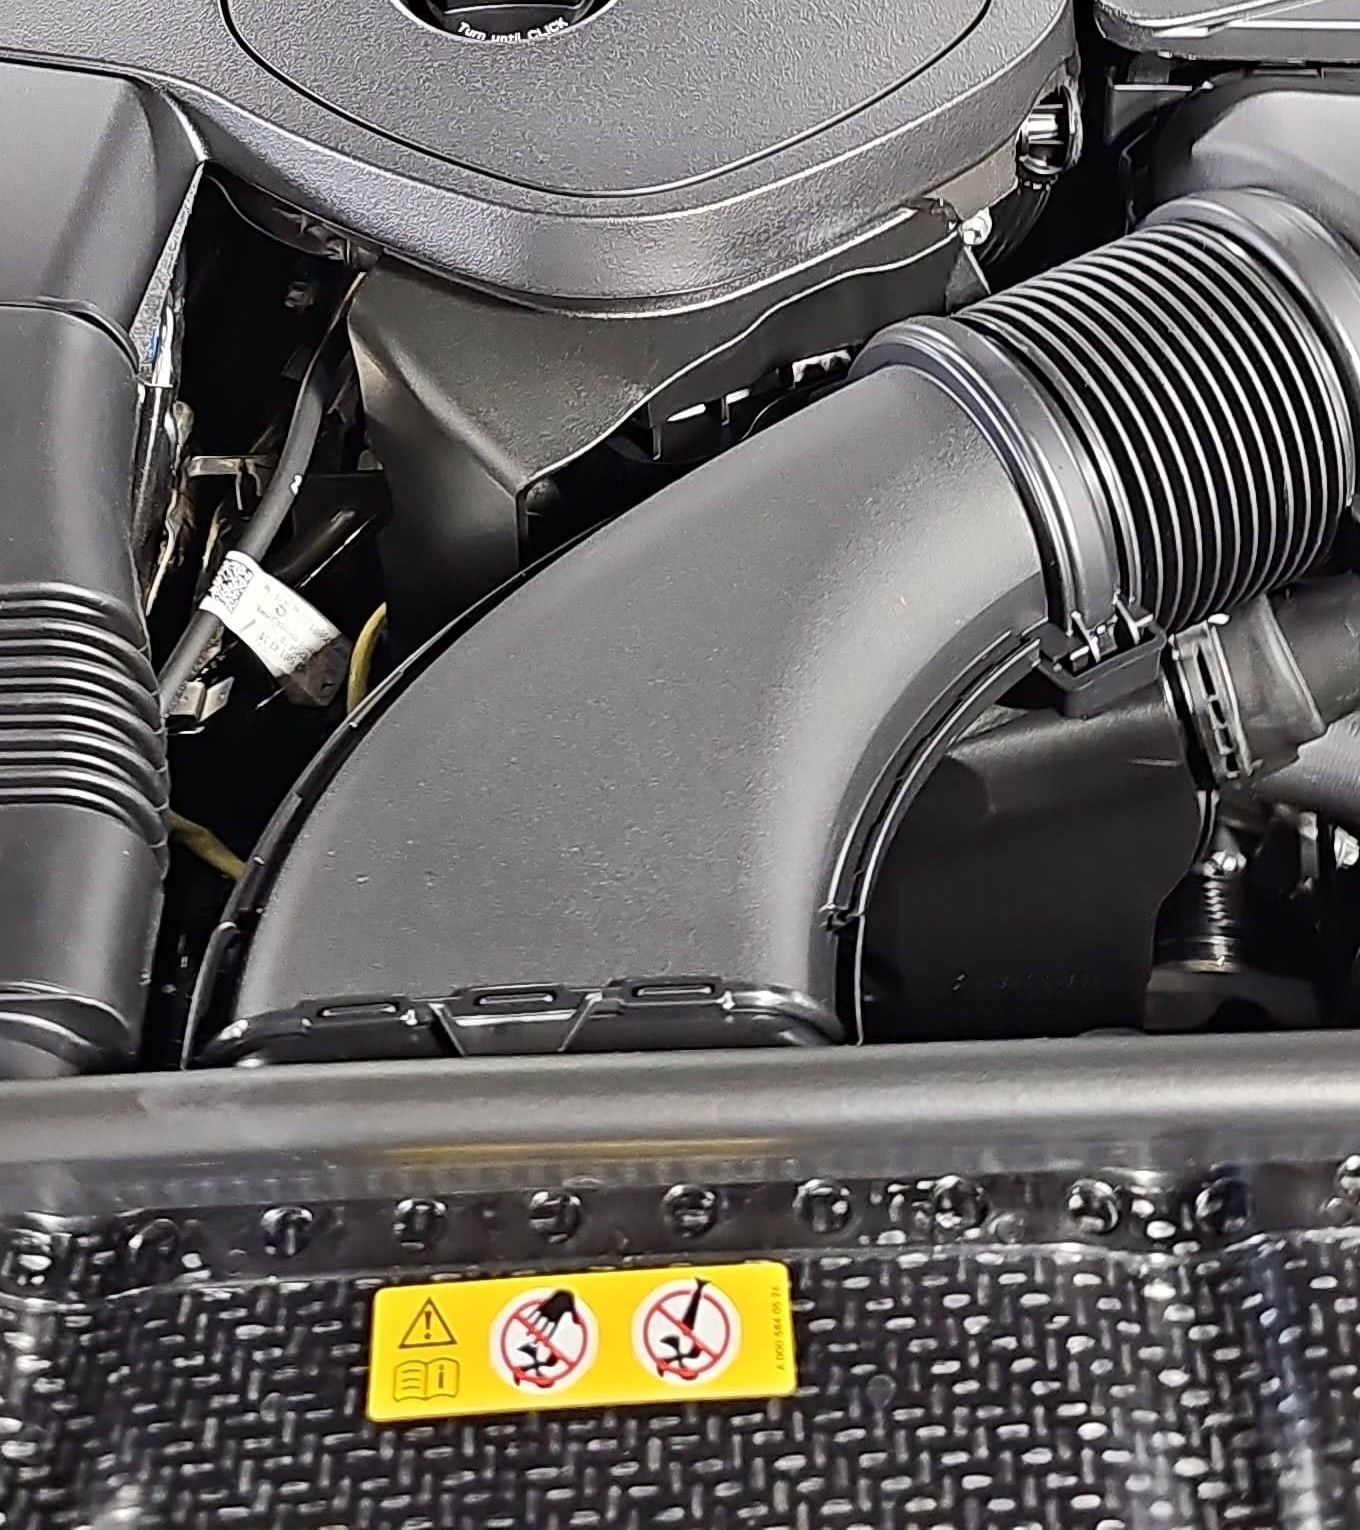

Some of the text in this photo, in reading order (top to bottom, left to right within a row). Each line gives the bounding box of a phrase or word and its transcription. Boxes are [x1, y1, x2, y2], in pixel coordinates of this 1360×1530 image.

[457, 17, 569, 43] Turn until CLICK
